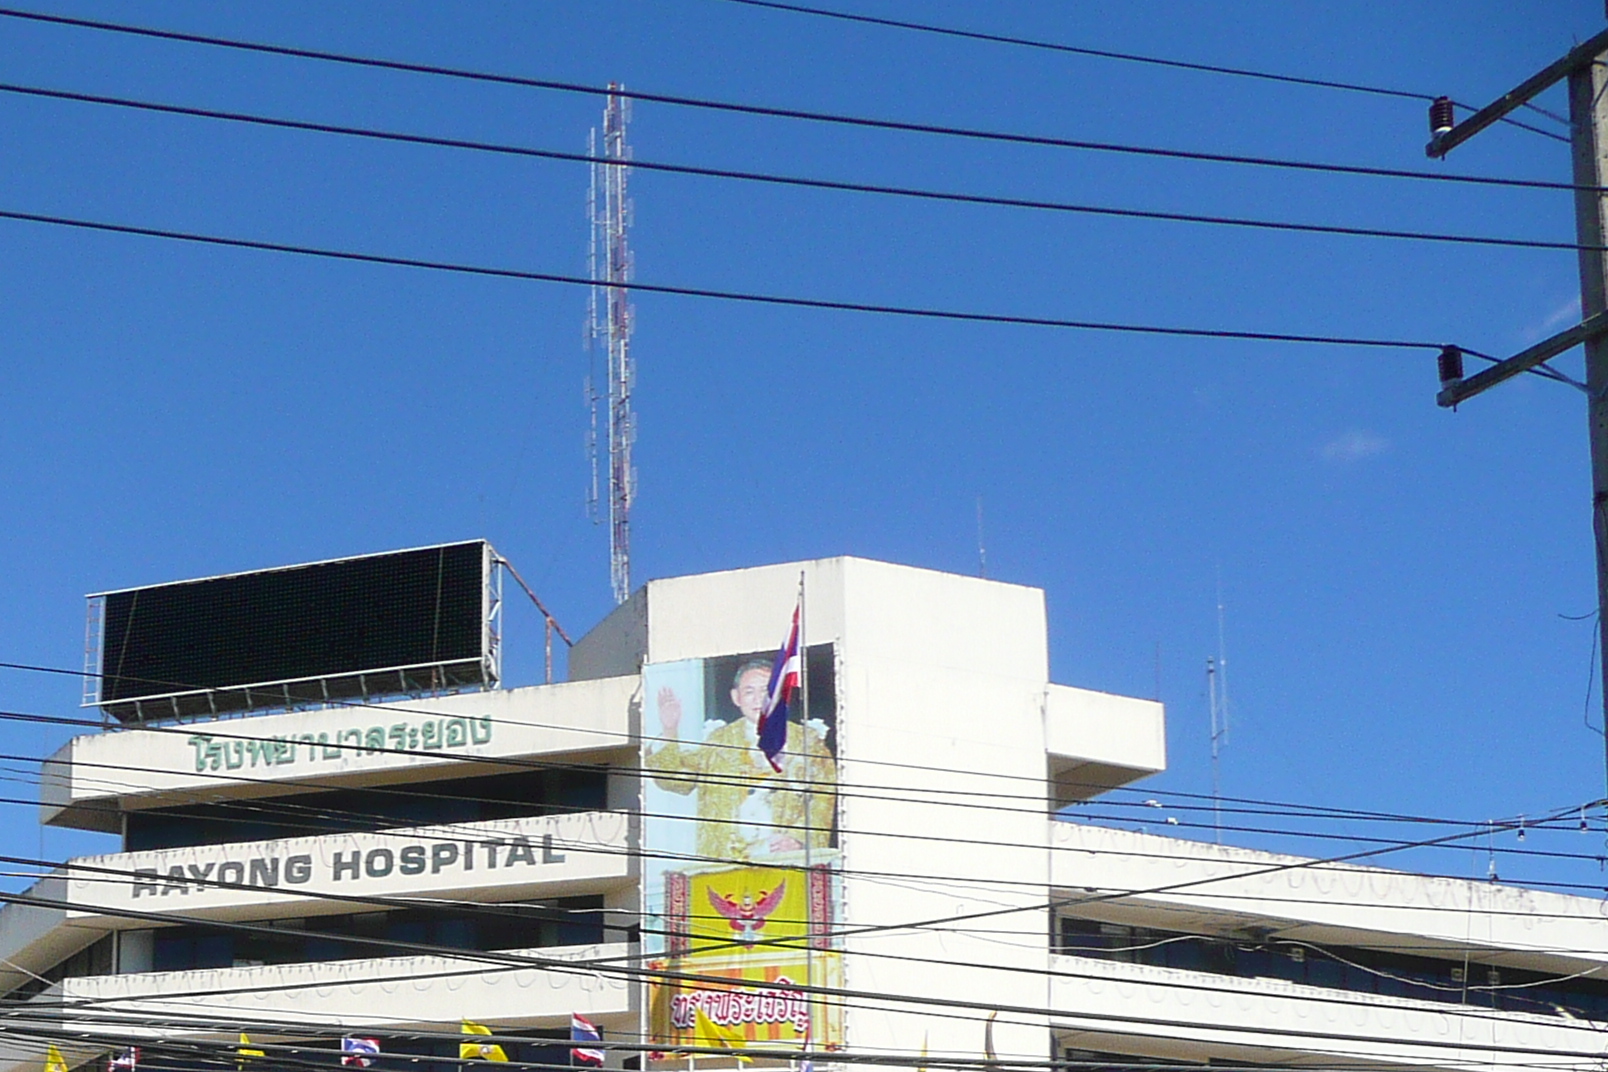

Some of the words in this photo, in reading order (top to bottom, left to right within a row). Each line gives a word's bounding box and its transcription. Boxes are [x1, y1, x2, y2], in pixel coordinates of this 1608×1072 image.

[188, 714, 491, 772] โรงพยาบาลระยอง
[132, 855, 312, 898] RAYONG
[332, 833, 566, 881] HOSPITAL
